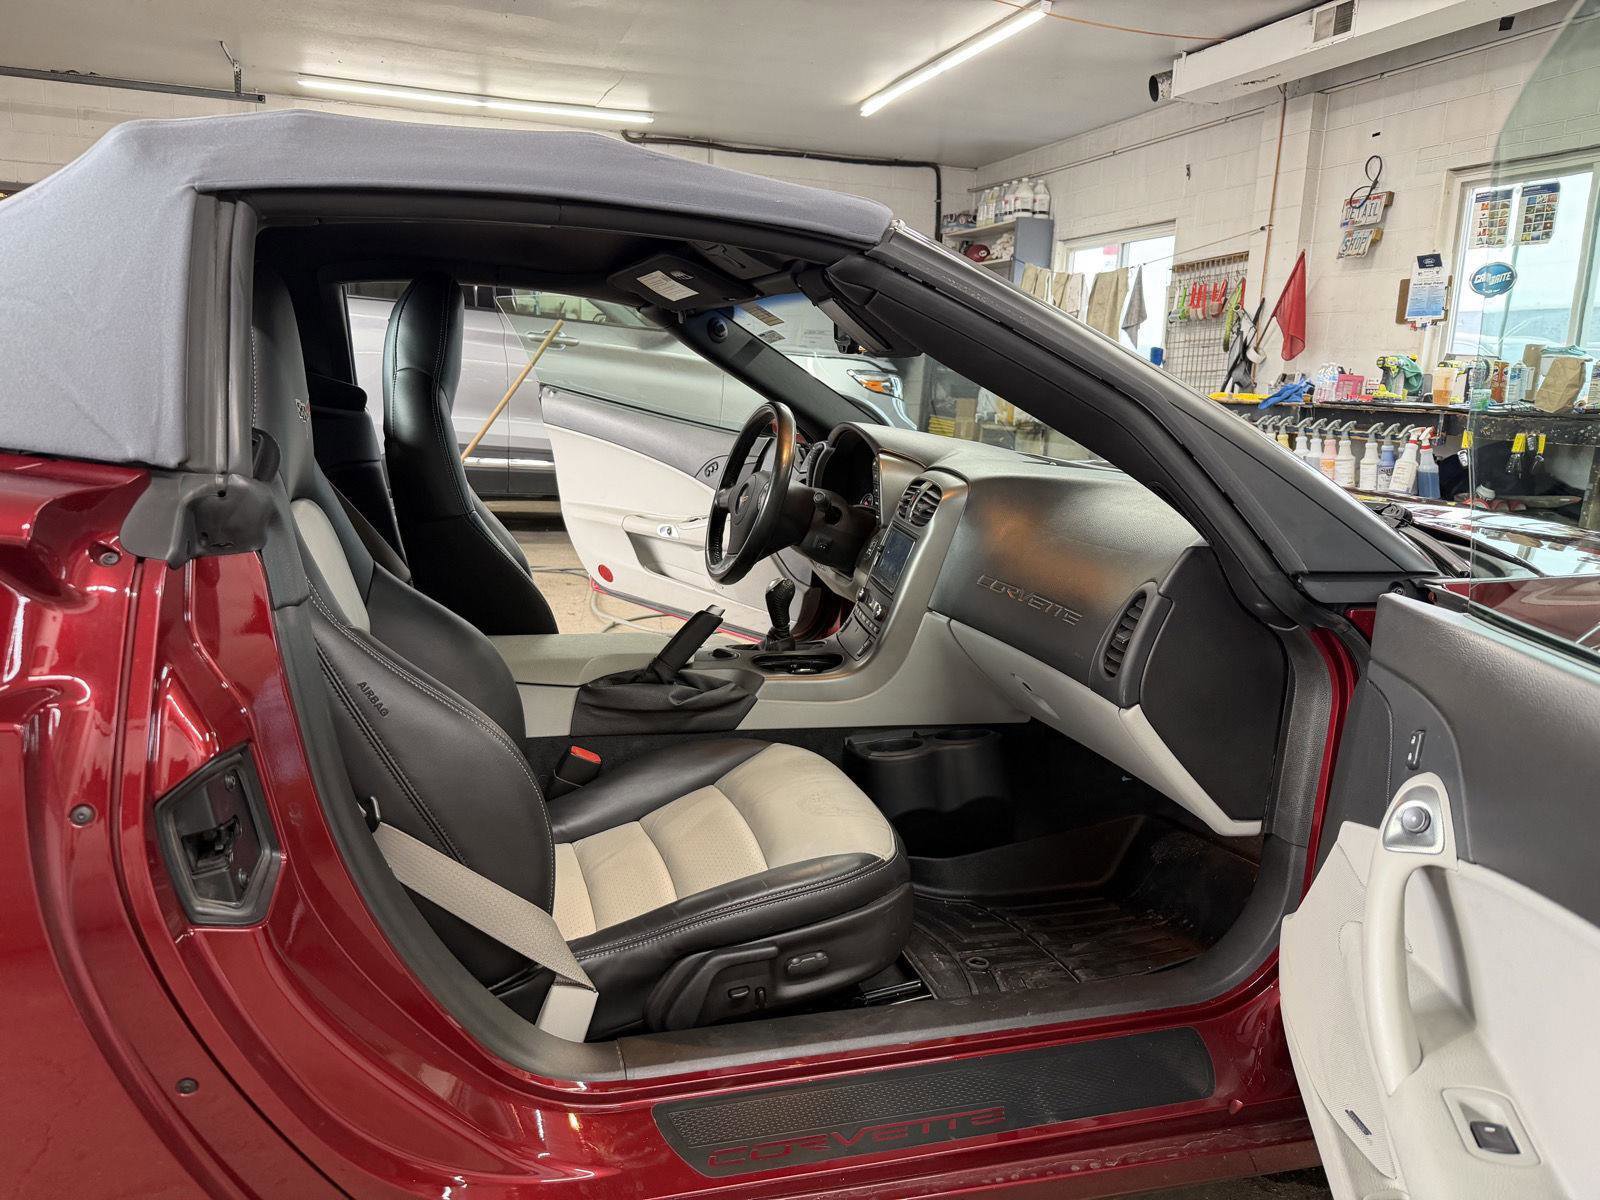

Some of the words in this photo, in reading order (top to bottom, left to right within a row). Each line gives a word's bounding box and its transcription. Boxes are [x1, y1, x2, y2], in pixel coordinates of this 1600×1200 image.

[1342, 236, 1368, 252] SHOP
[976, 574, 1084, 627] CORVETTE
[357, 681, 389, 717] AIRBAG
[707, 1106, 1005, 1168] CORVETTE
